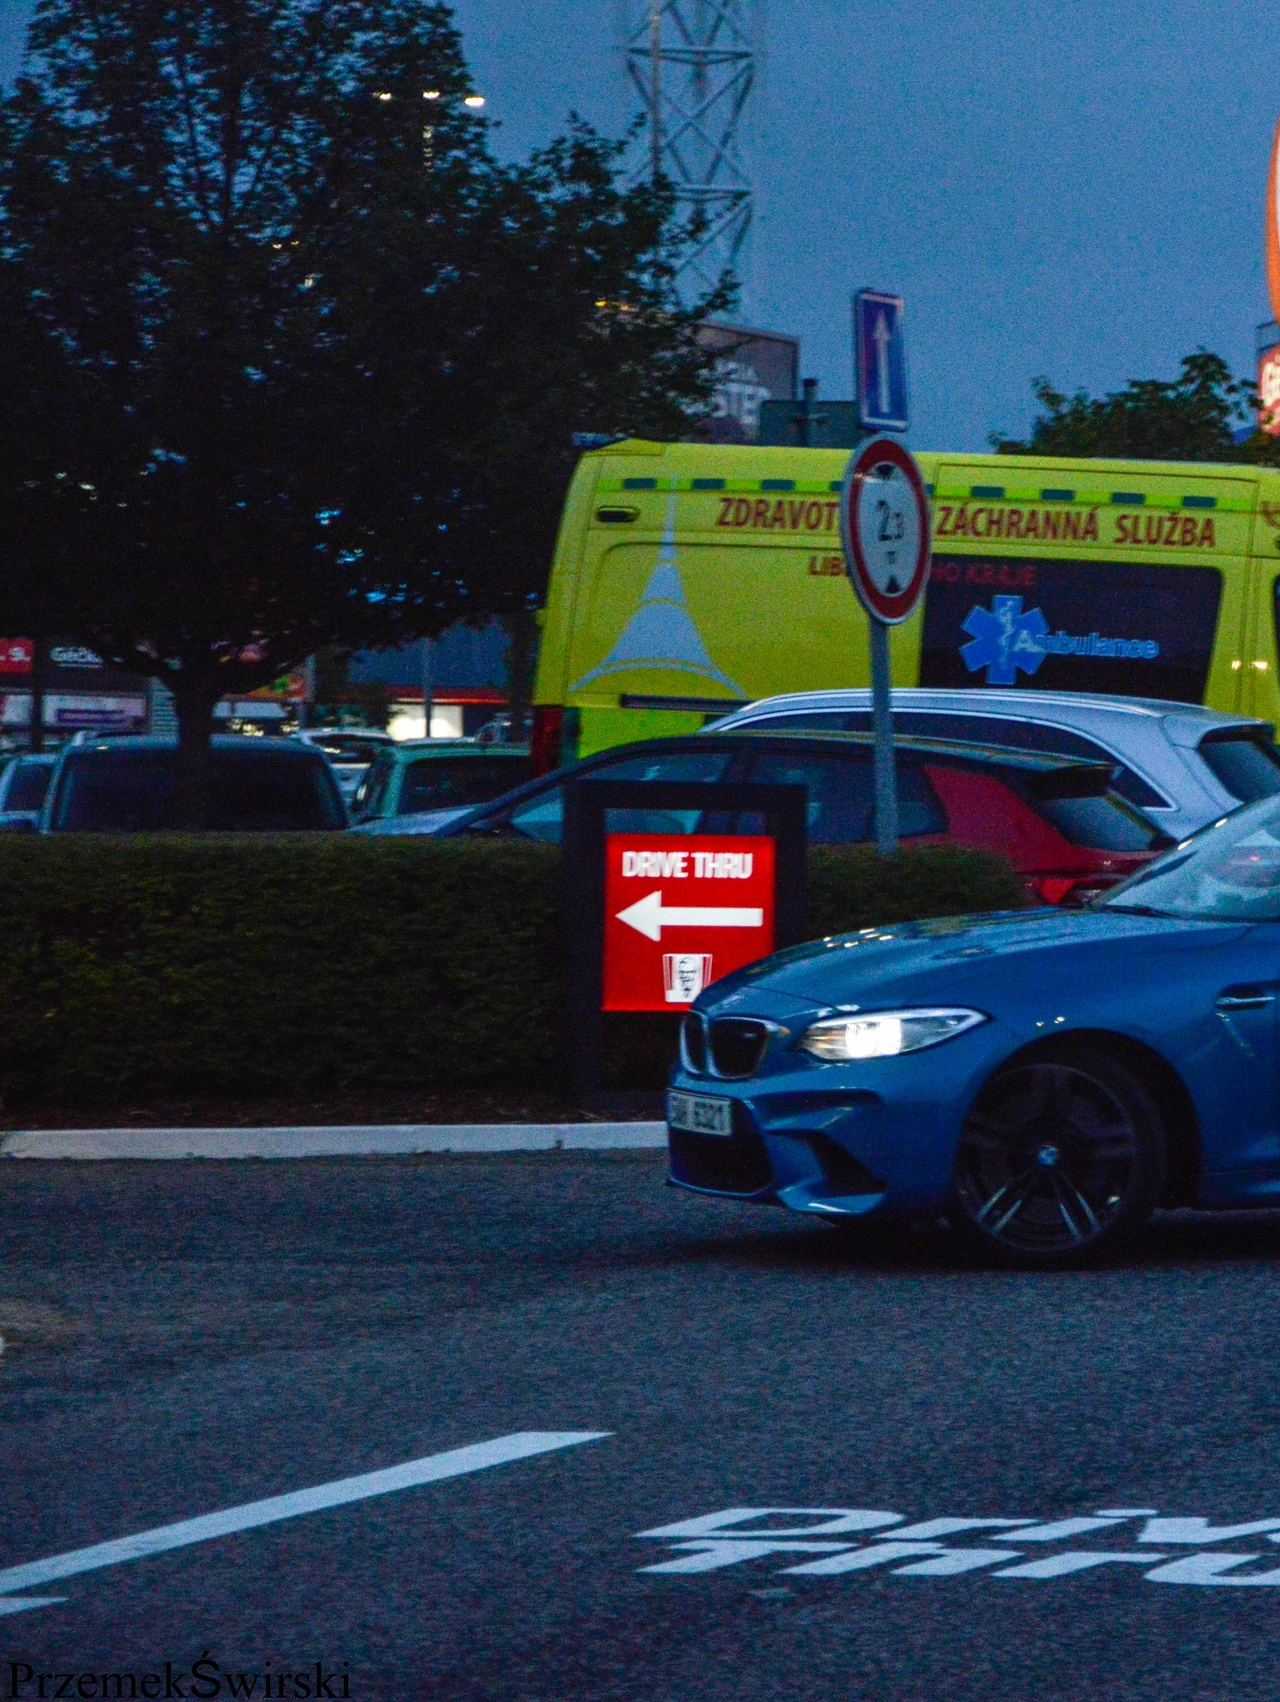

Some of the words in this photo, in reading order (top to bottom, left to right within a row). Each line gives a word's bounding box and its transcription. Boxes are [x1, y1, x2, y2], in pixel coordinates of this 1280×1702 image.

[717, 497, 841, 532] ZDRAVOT
[935, 501, 1099, 542] ZÁCHRANNÁ
[1113, 510, 1217, 548] SLUŽBA
[1013, 628, 1160, 660] Ambulance
[621, 850, 689, 878] DRIVE
[690, 852, 753, 879] THRU
